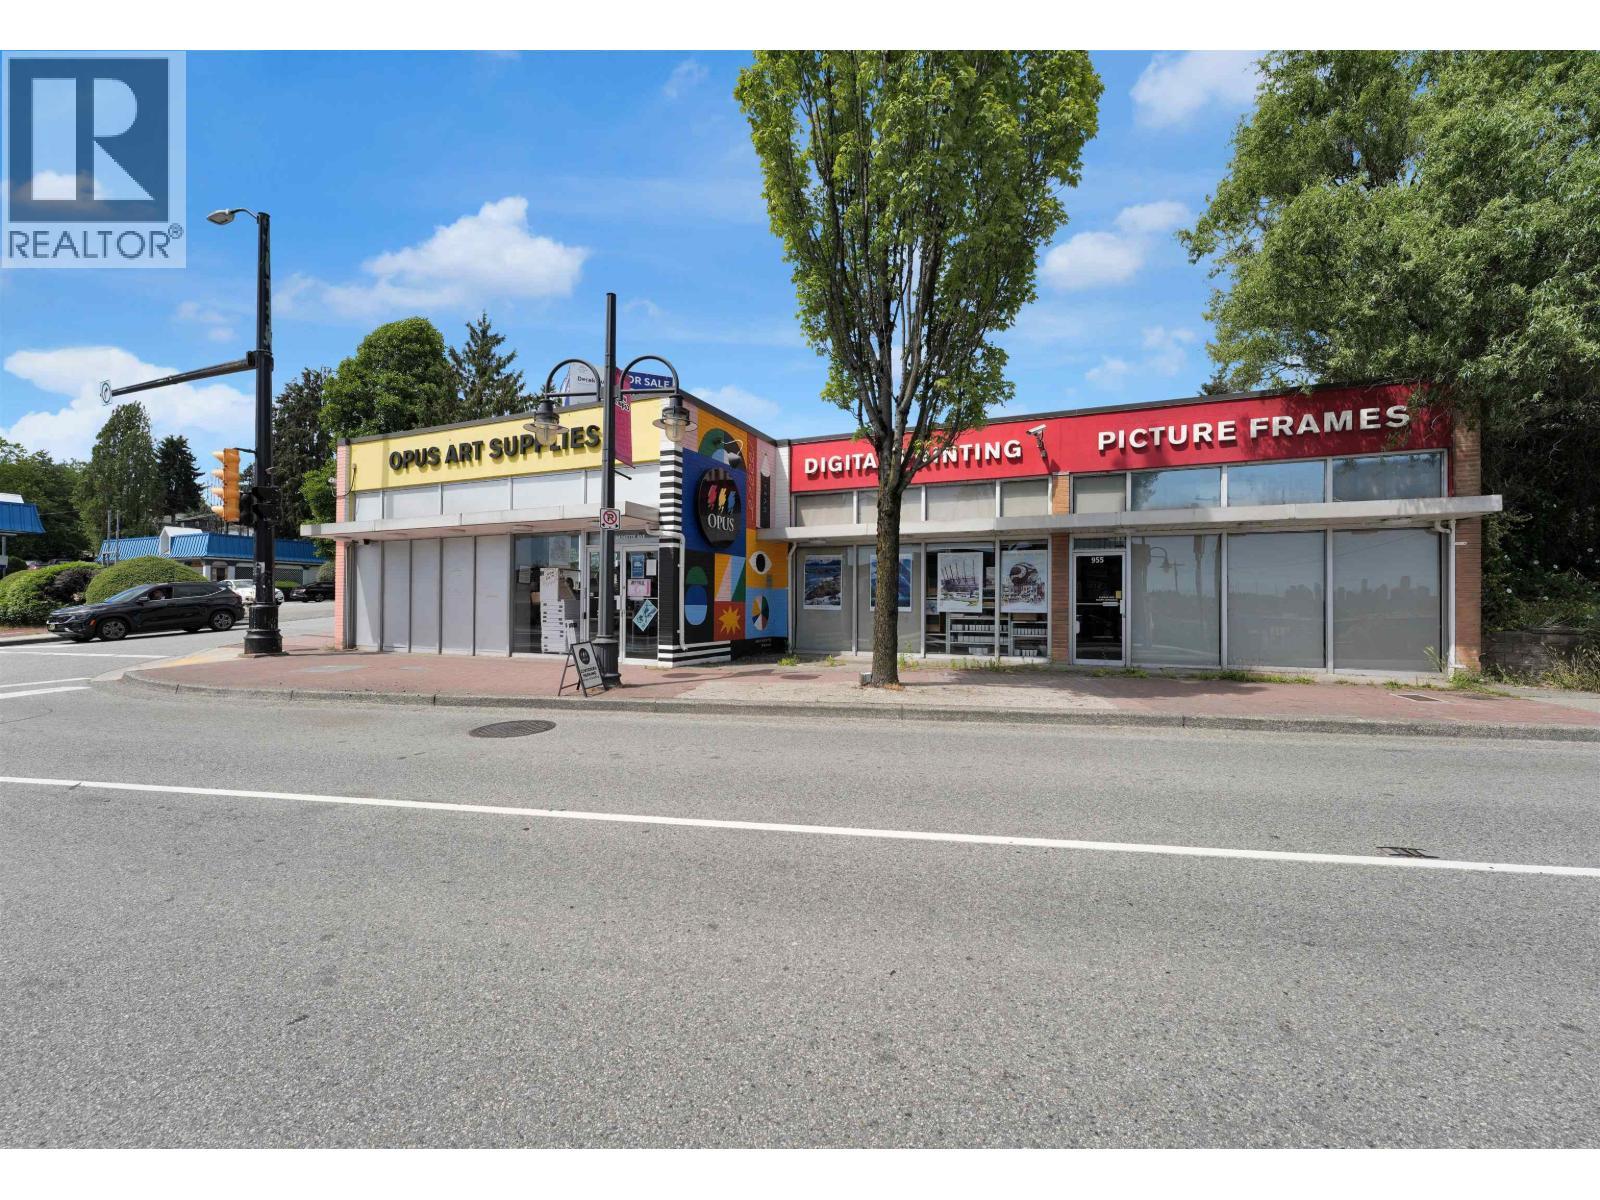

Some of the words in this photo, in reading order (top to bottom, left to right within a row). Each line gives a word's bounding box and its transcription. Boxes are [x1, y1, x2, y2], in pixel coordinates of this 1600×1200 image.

[644, 377, 670, 389] SALE
[1097, 419, 1238, 451] PICTURE
[1249, 404, 1411, 439] FRAMES
[389, 445, 442, 471] OPUS
[444, 440, 484, 464] ART
[804, 452, 877, 475] DIGITA
[707, 513, 735, 532] OPUS
[1091, 556, 1105, 564] 955
